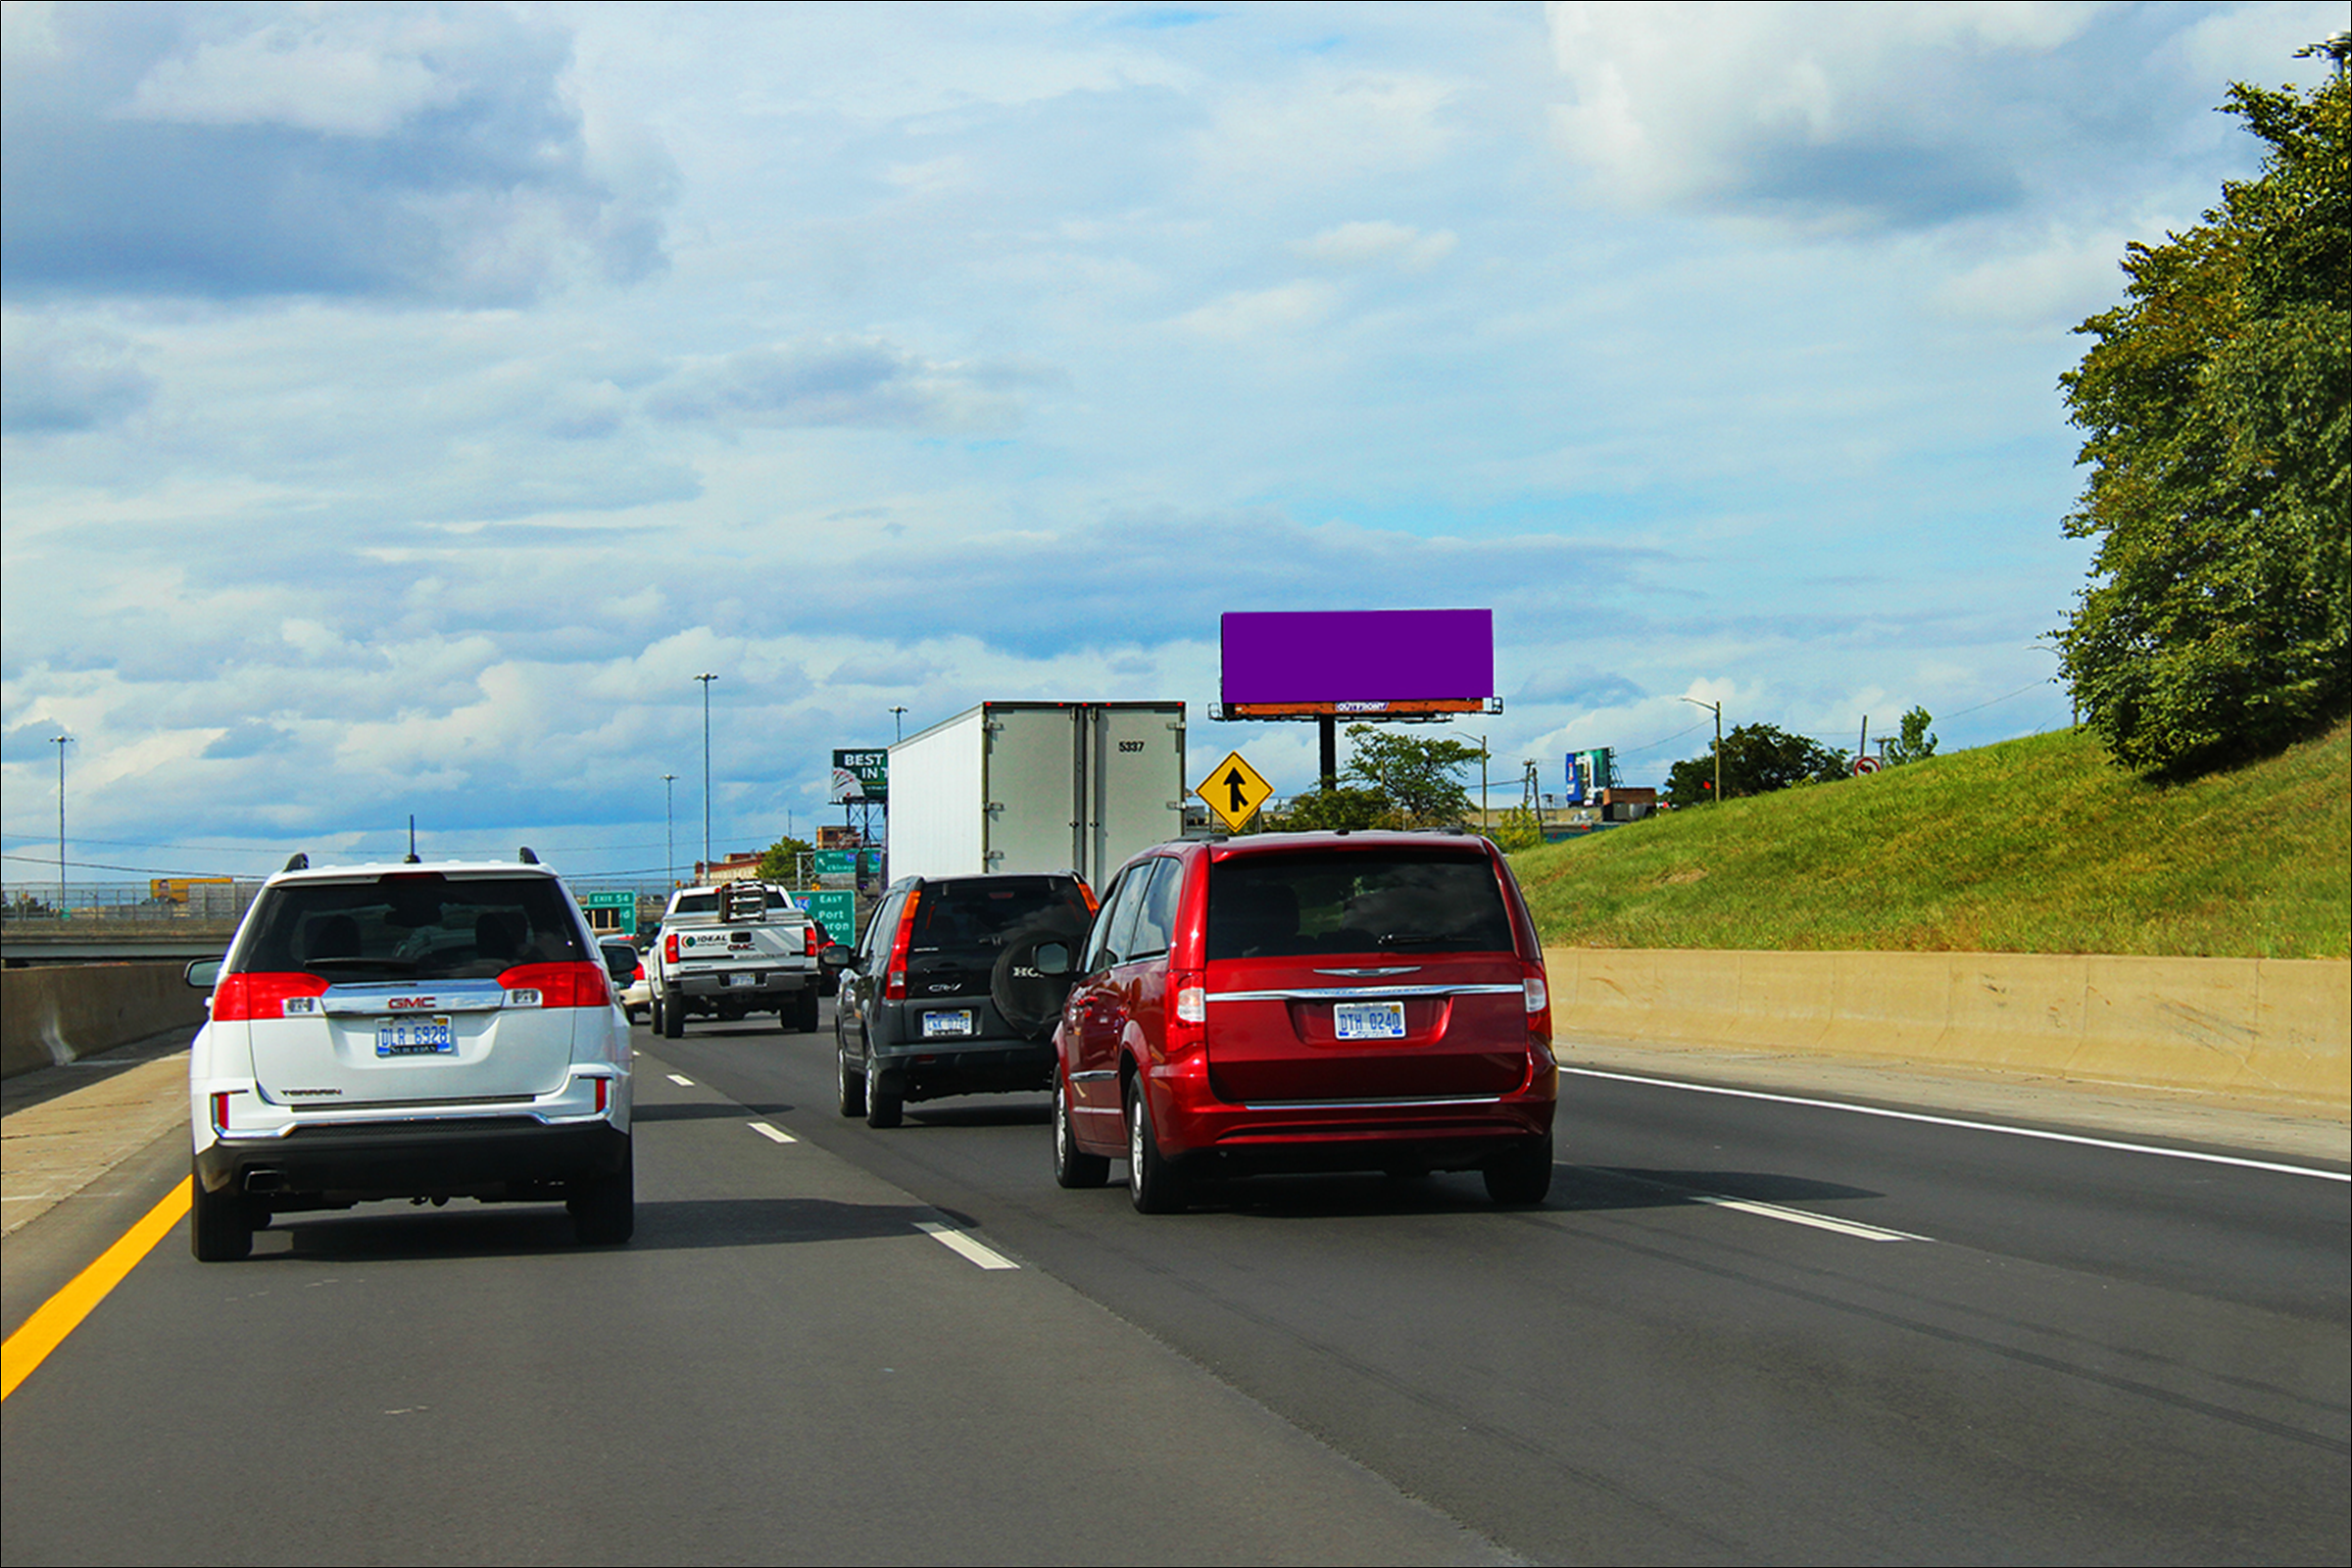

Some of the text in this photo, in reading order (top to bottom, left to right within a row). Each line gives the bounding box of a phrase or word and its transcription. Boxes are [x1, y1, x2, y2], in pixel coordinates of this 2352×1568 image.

[1118, 740, 1145, 753] 5337
[844, 754, 884, 766] BEST
[861, 766, 888, 779] IN T
[615, 894, 629, 903] 54
[819, 895, 843, 904] EAST
[818, 910, 844, 919] Port
[388, 996, 436, 1009] GMC
[1340, 1011, 1400, 1031] DTH 0240
[380, 1025, 448, 1047] DLR 6928
